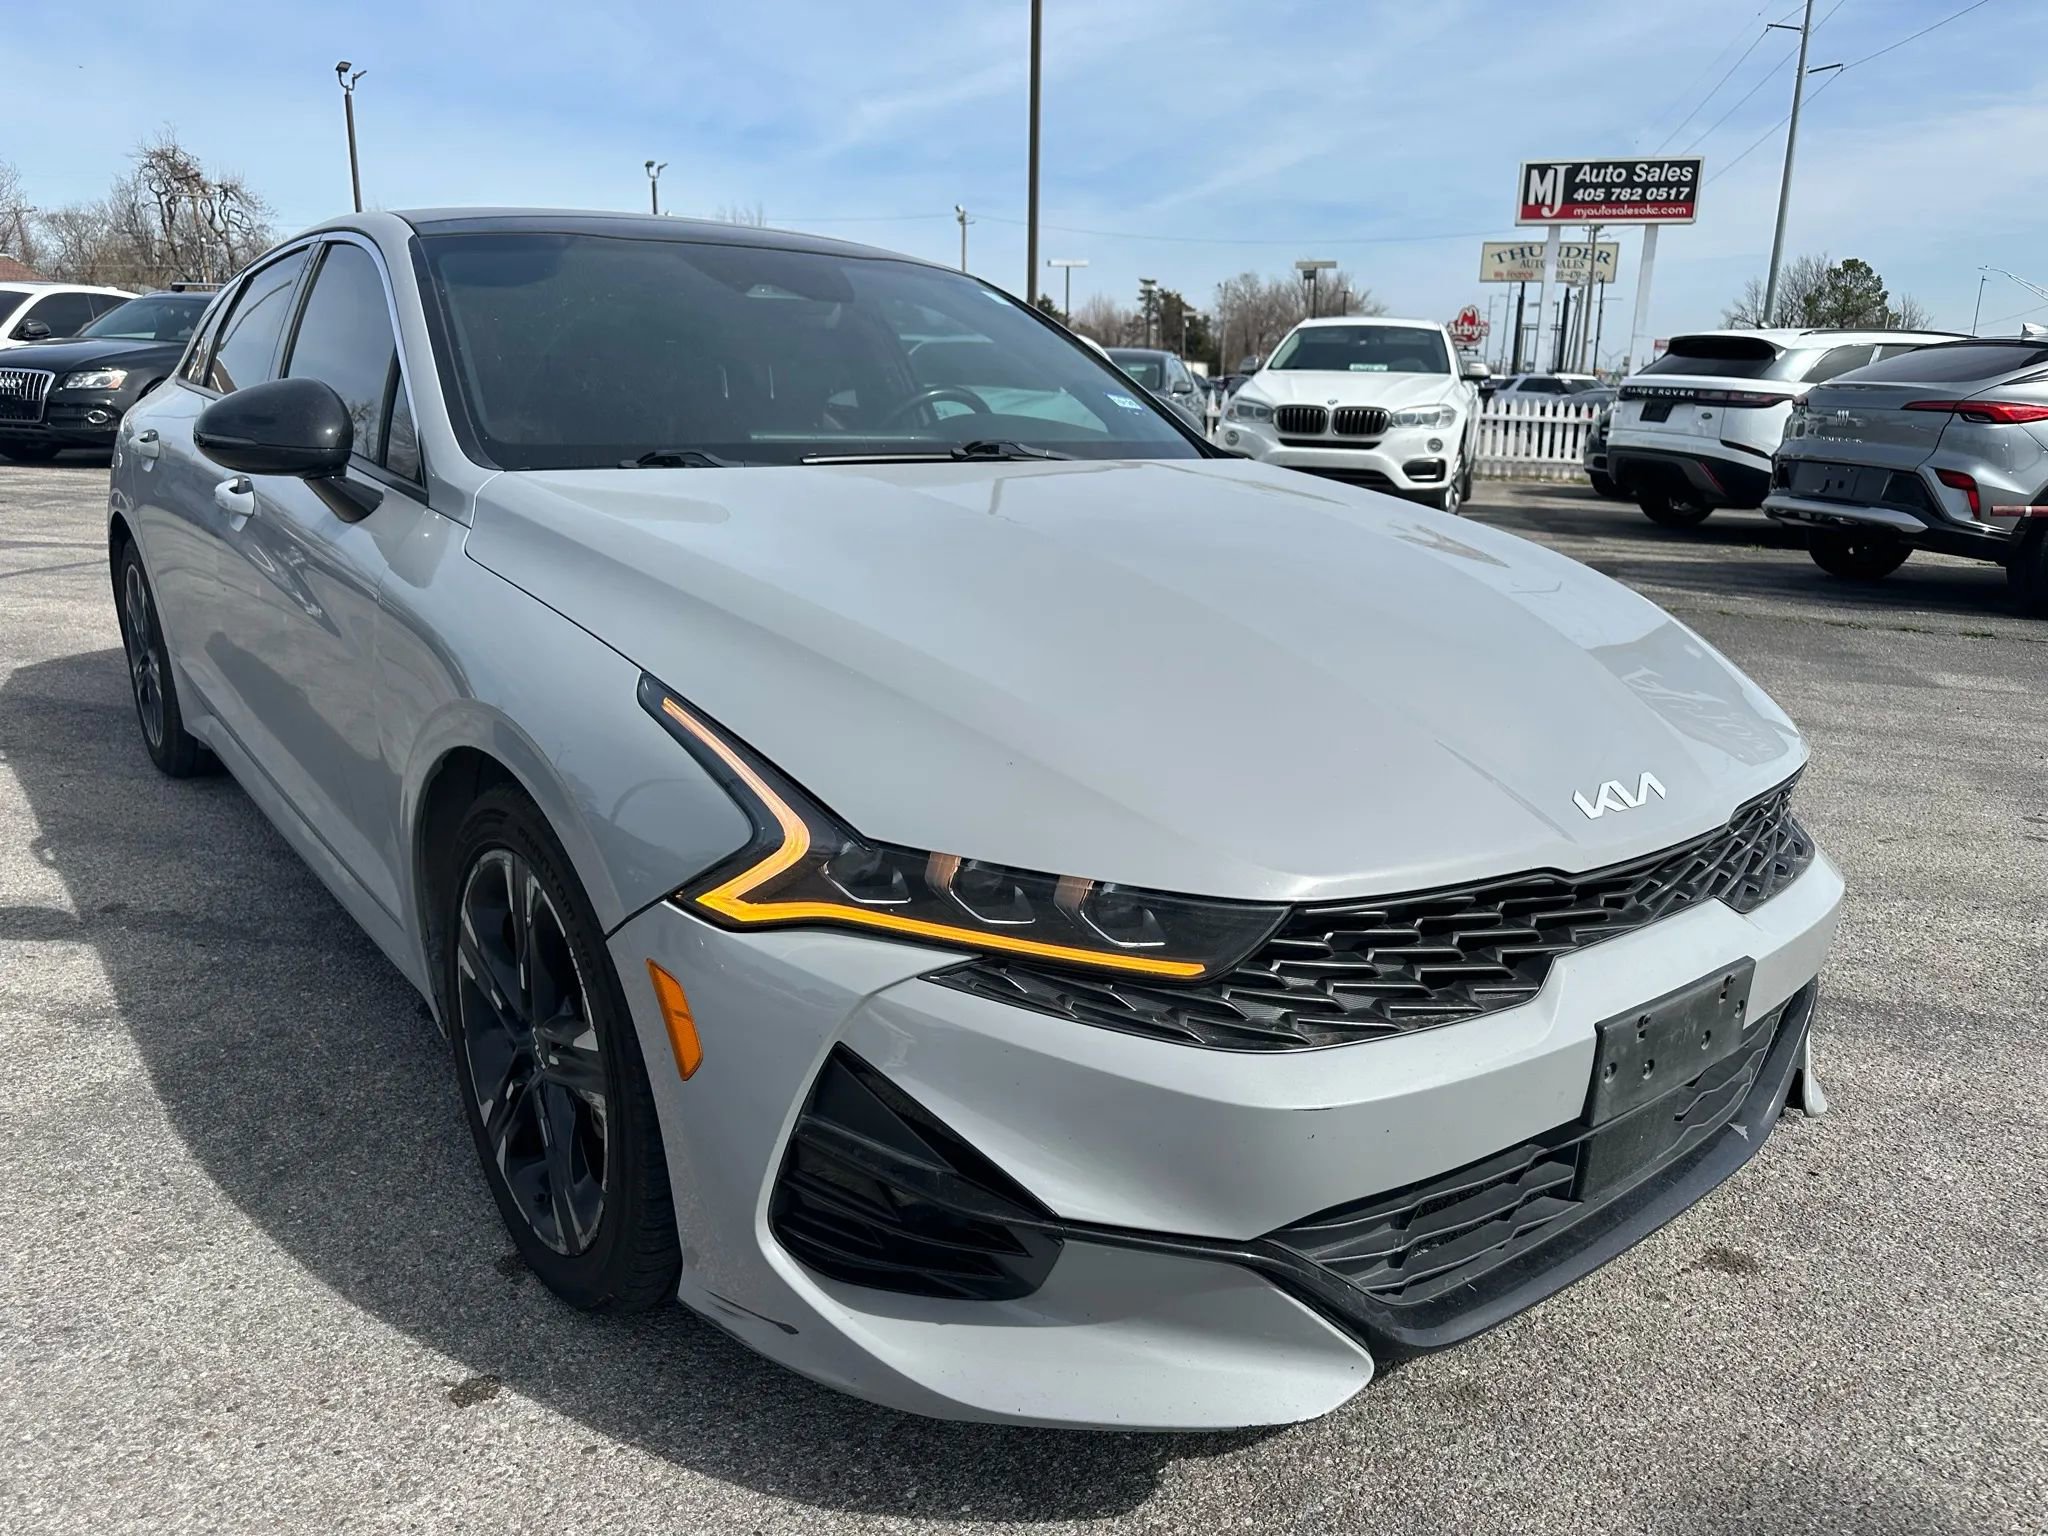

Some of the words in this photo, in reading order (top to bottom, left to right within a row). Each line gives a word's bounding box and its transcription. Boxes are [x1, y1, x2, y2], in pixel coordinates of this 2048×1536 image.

[1575, 164, 1627, 183] Auto
[1633, 163, 1693, 182] Sales
[1528, 165, 1572, 218] MJ
[1573, 188, 1605, 201] 405
[1611, 188, 1642, 201] 782
[1646, 187, 1690, 200] 0517
[1573, 204, 1686, 219] mjautosalesokc.com
[1447, 322, 1489, 339] Arby's
[1626, 387, 1653, 395] RANGE
[1658, 388, 1695, 397] ROVER
[1573, 771, 1666, 820] KIA
